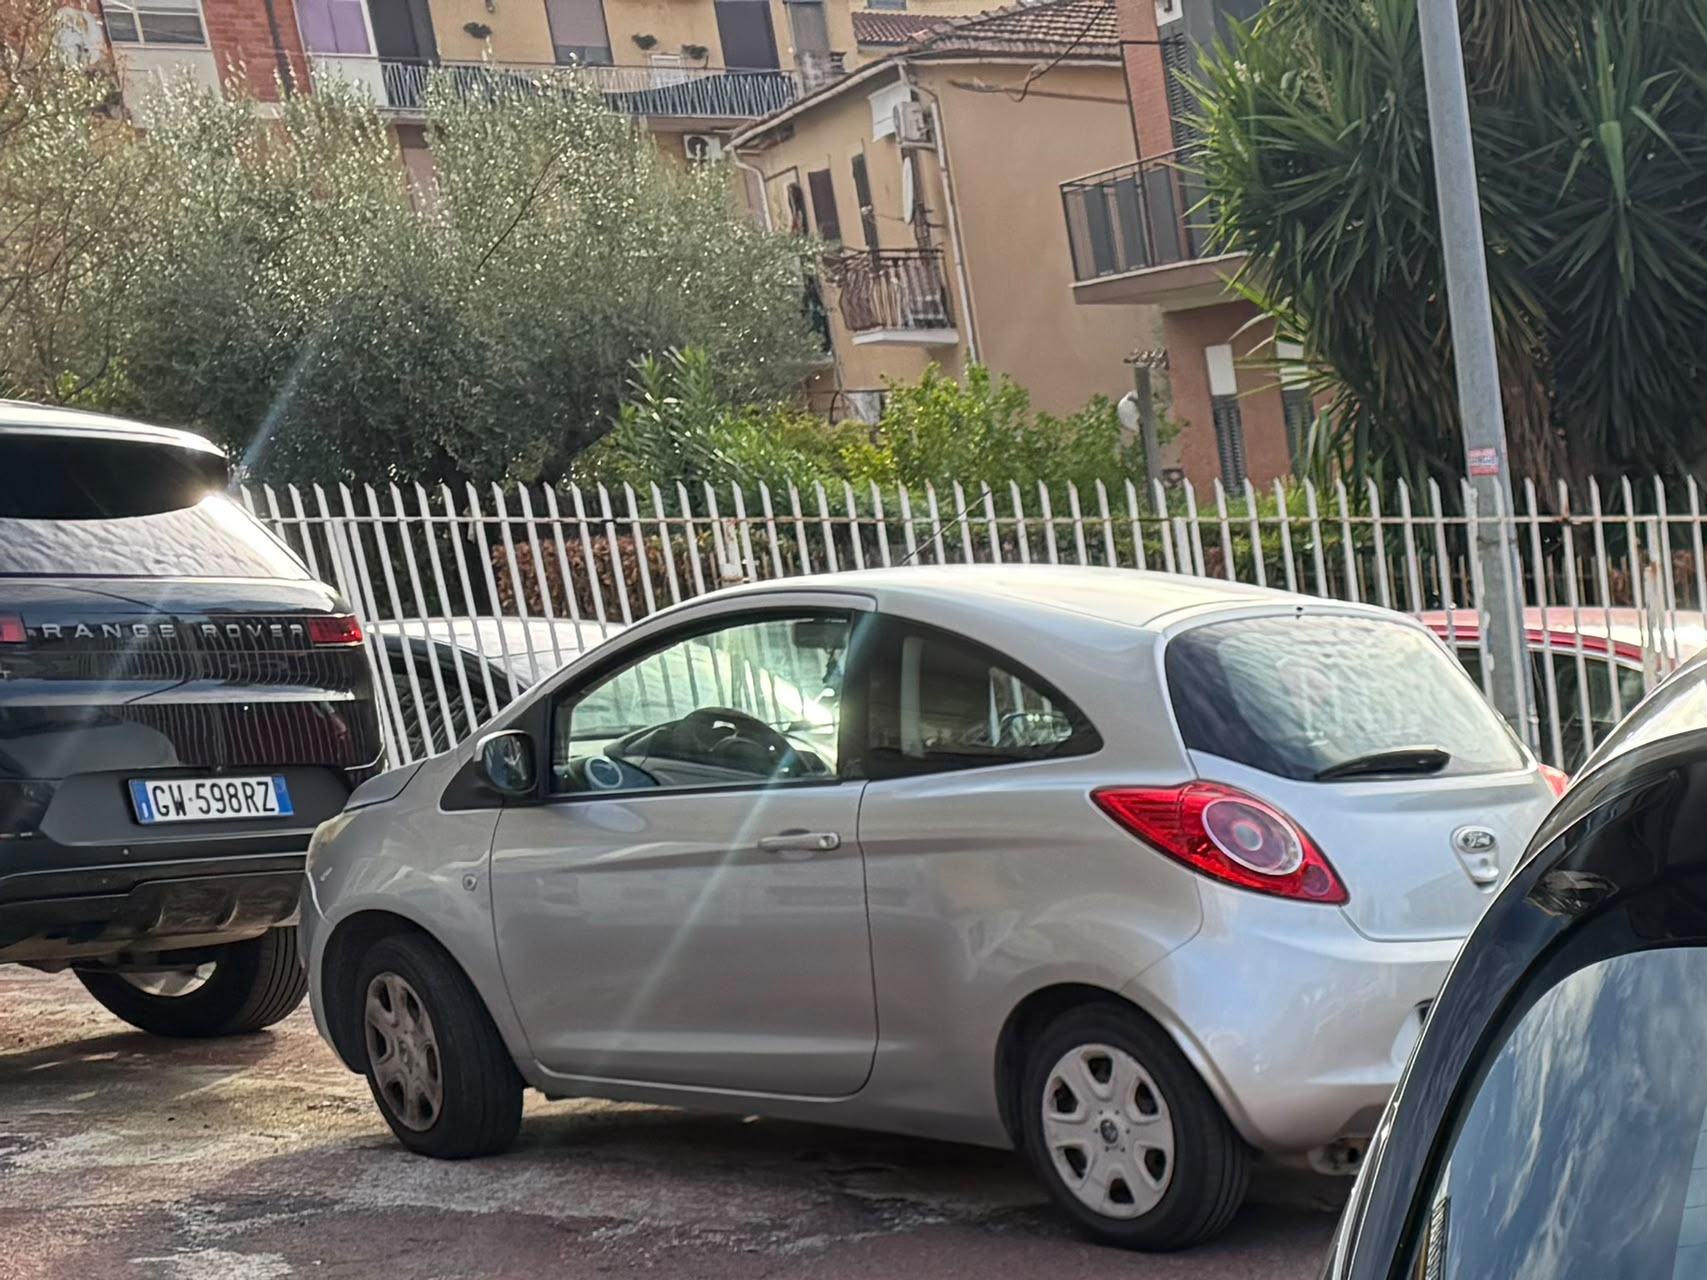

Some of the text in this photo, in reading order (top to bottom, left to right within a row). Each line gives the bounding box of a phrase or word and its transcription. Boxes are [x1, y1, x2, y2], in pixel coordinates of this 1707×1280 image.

[42, 623, 304, 639] RANGE ROVER
[152, 781, 275, 817] GW 598RZ
